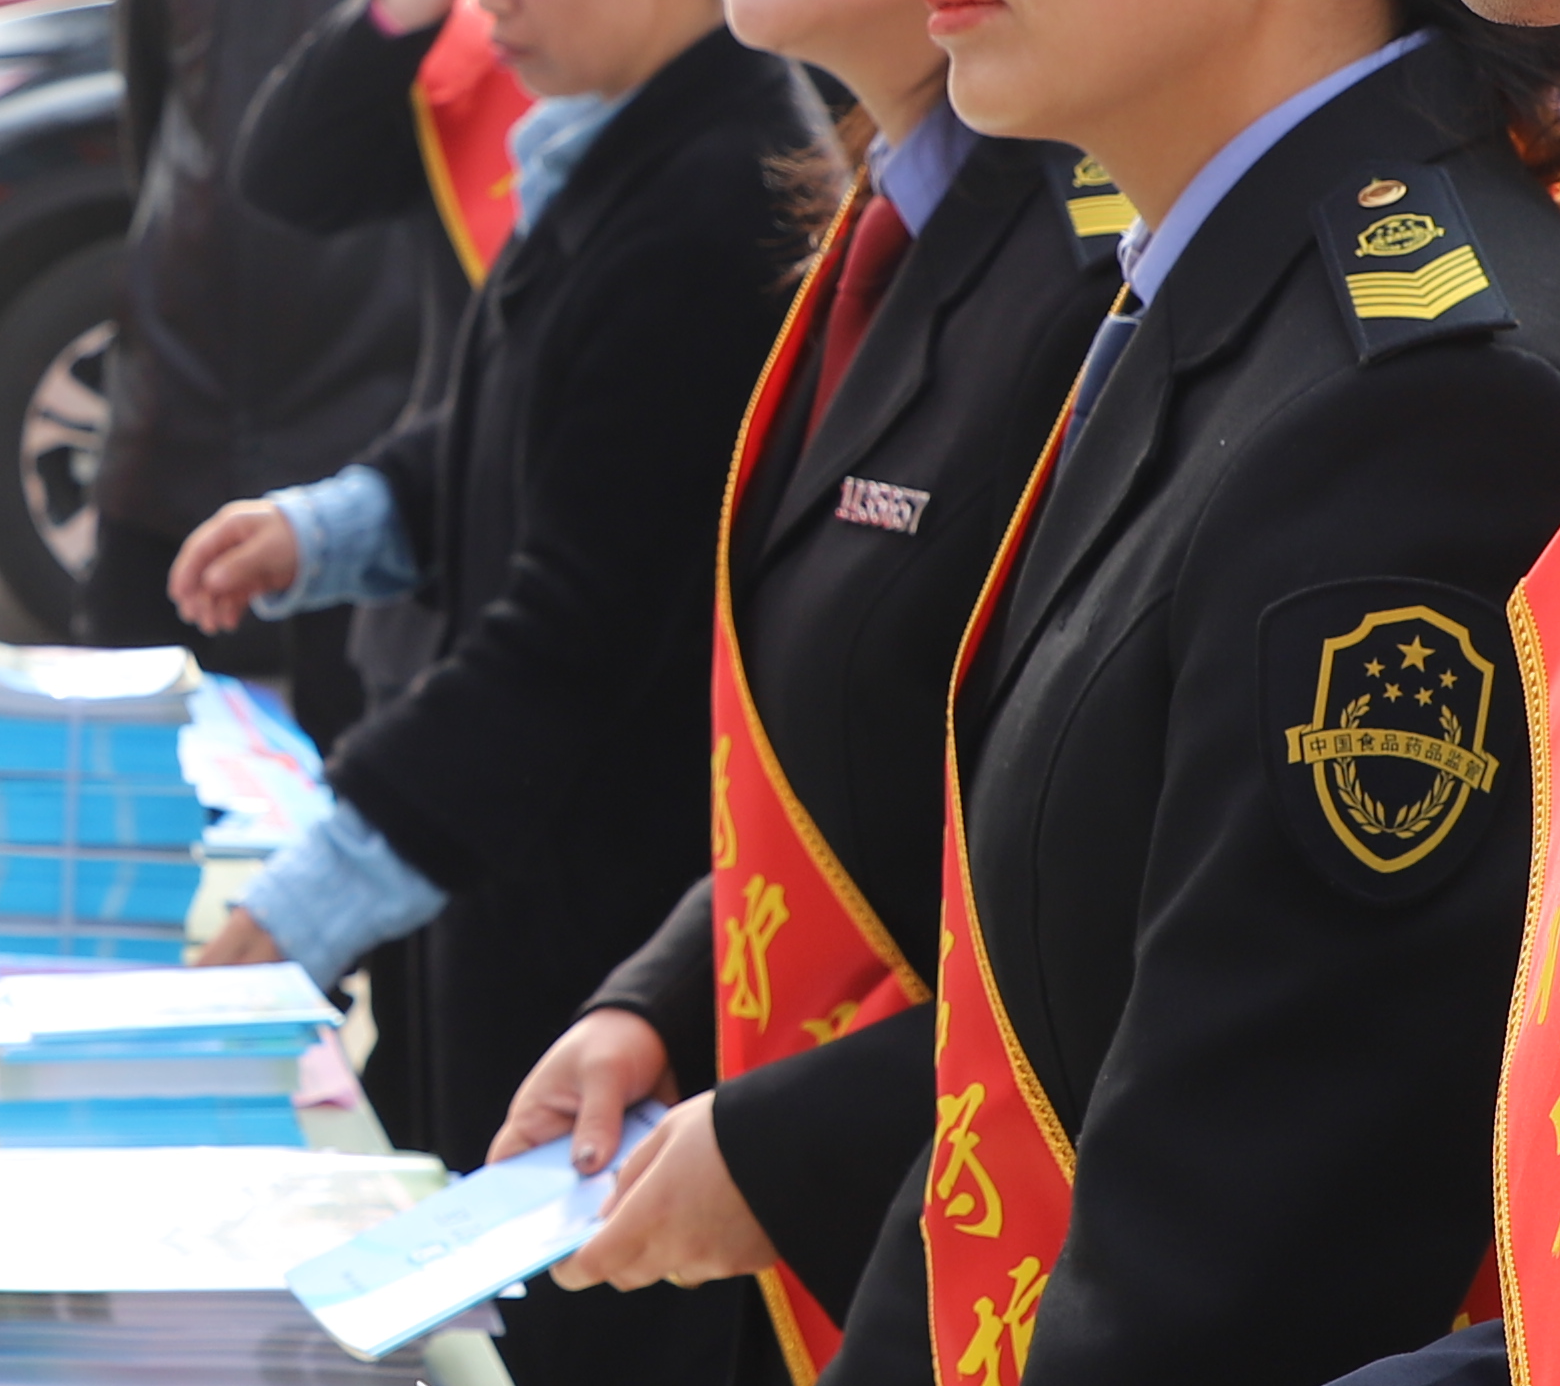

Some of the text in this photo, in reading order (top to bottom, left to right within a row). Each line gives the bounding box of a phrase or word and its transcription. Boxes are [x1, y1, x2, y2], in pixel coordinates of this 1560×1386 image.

[1309, 732, 1483, 784] 中国食品药品监管
